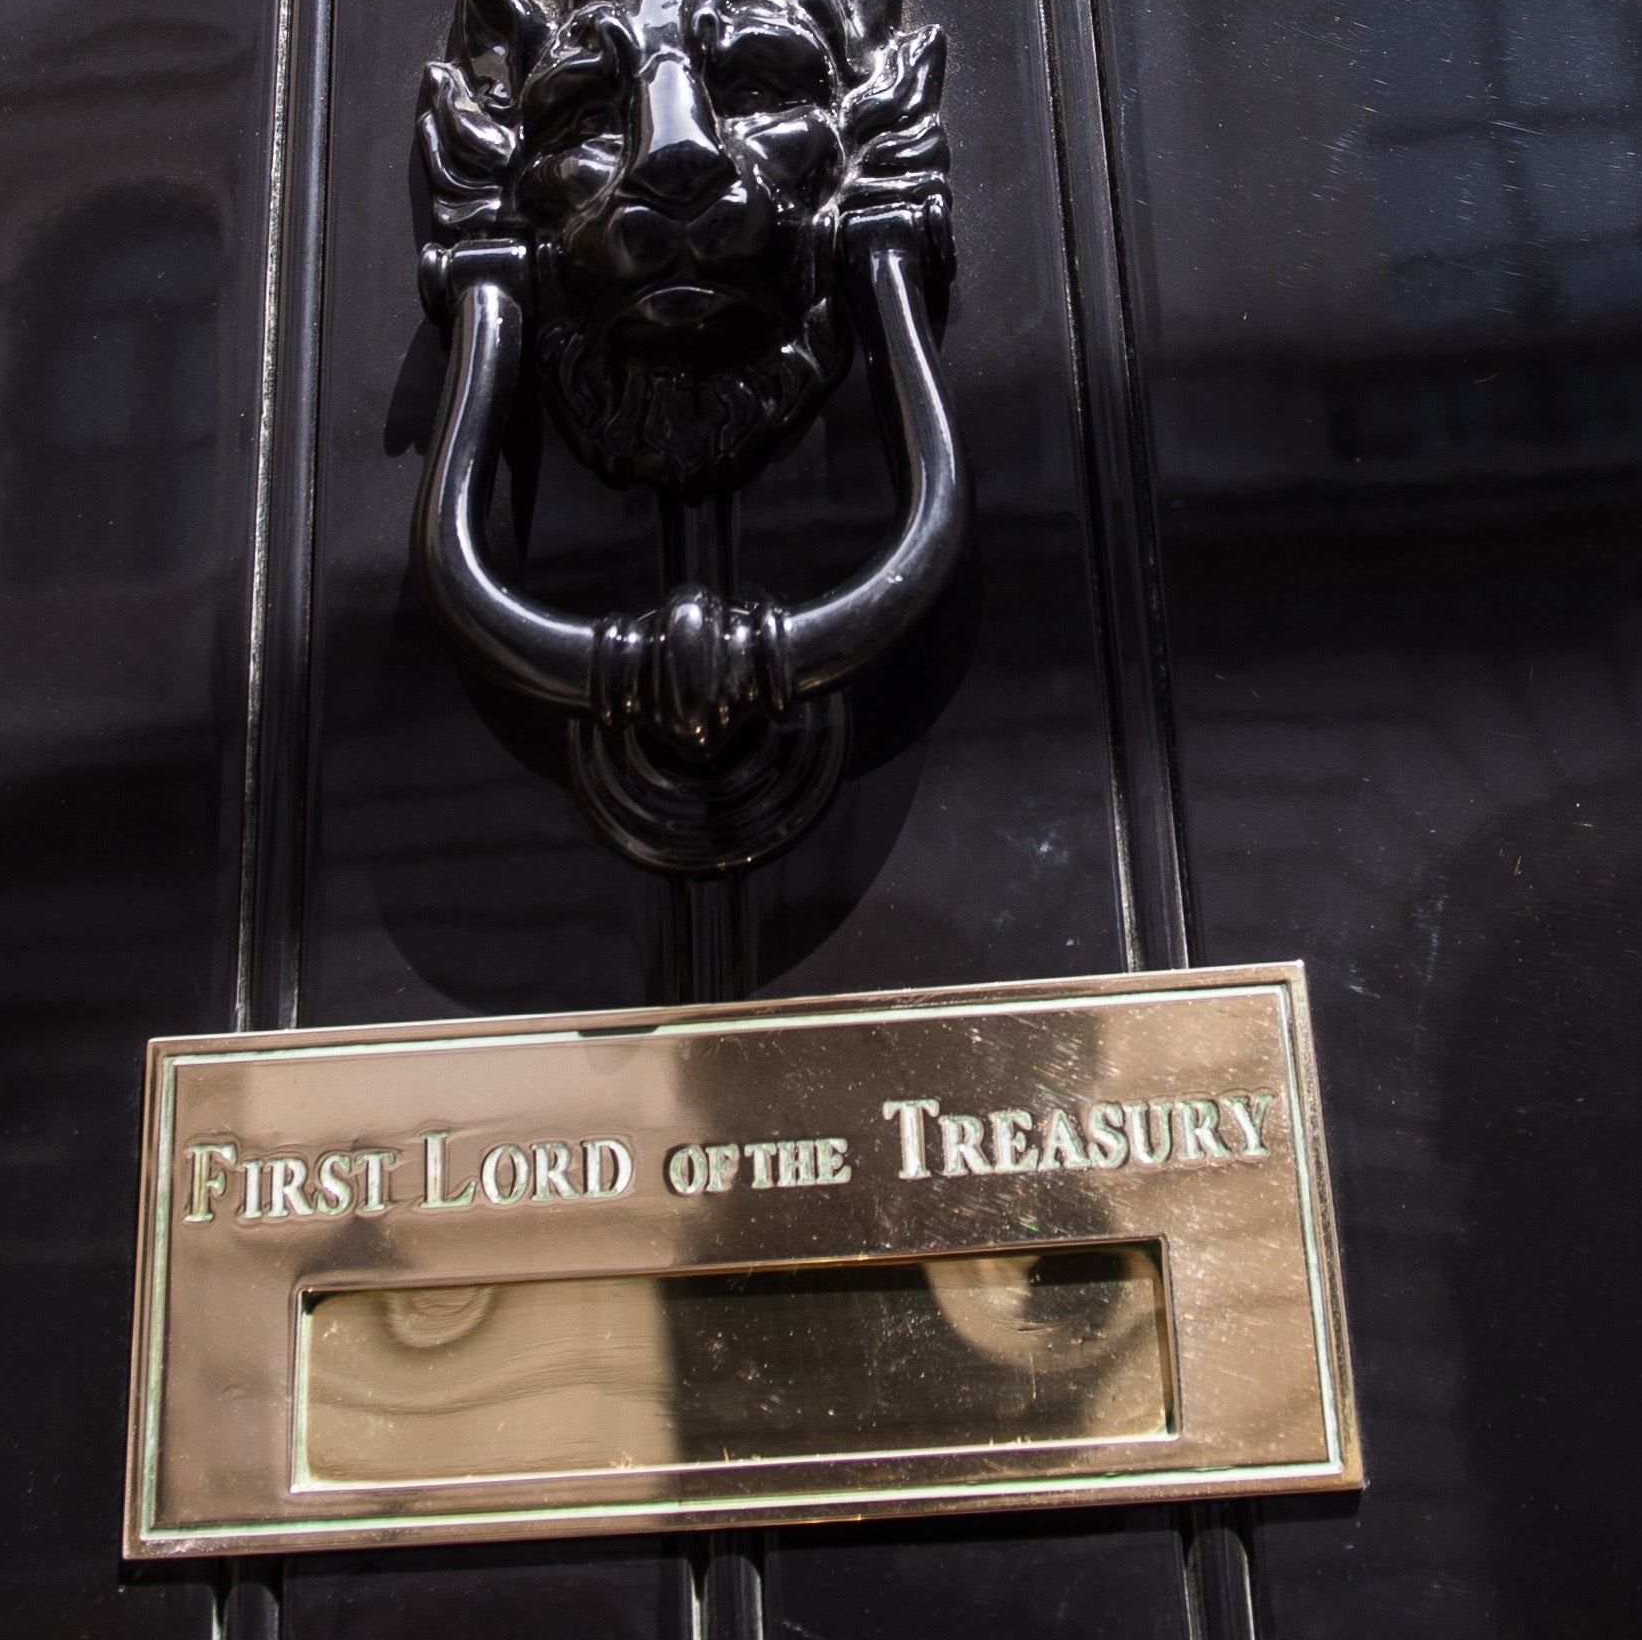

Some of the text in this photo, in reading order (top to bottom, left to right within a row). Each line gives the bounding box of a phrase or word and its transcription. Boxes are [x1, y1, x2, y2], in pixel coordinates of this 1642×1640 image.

[184, 1095, 1274, 1224] FIRST LORD OF THE TREASURY
